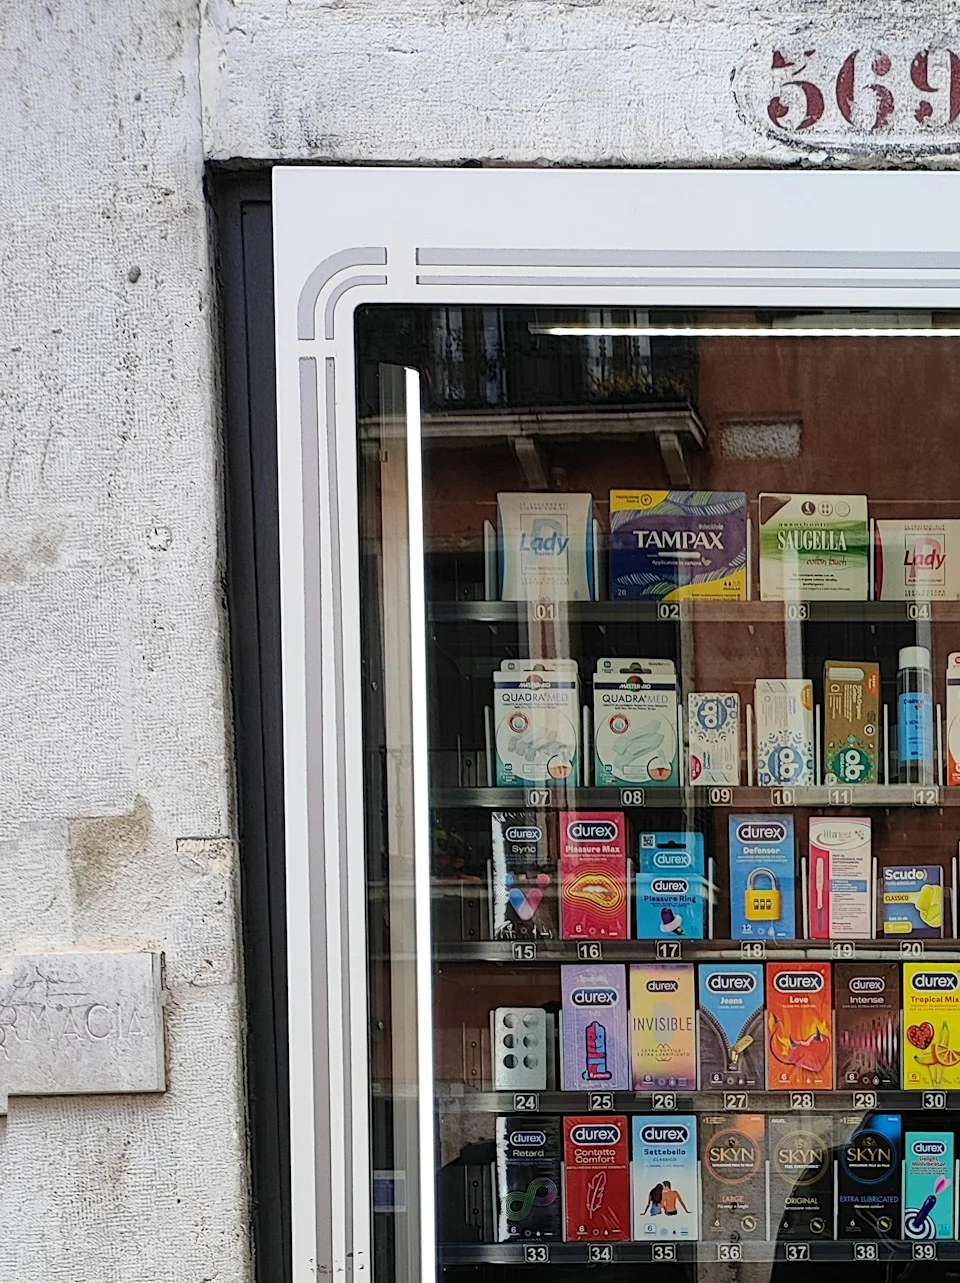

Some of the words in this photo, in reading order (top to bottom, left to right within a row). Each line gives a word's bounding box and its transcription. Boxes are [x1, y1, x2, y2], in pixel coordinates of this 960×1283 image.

[519, 532, 569, 557] Lady
[632, 530, 724, 550] TAMPAX
[777, 529, 848, 552] SAUGELLA
[903, 550, 946, 569] Lady
[536, 604, 554, 619] 01
[660, 604, 679, 619] 02
[788, 604, 807, 619] 03
[909, 605, 929, 619] 04
[508, 828, 540, 840] durex
[571, 823, 614, 840] durex
[740, 823, 783, 840] durex
[511, 844, 537, 855] Sync
[565, 845, 601, 854] Pleasure
[603, 845, 620, 854] Max
[743, 846, 781, 856] Defensor
[656, 852, 689, 867] durex
[885, 868, 925, 881] Scudo
[654, 879, 686, 893] durex
[644, 895, 677, 903] Pleasure
[678, 895, 697, 904] Ring
[885, 894, 909, 902] CLASSICO
[647, 980, 677, 992] durex
[710, 975, 753, 990] durex
[778, 975, 820, 990] durex
[851, 979, 883, 991] durex
[914, 973, 956, 989] durex
[574, 991, 614, 1004] durex
[720, 996, 744, 1006] Jeans
[789, 995, 809, 1005] Love
[850, 995, 884, 1004] Intense
[910, 995, 944, 1004] Tropical
[944, 995, 960, 1004] Mix
[633, 1017, 693, 1032] INVISIBLE
[516, 1095, 536, 1109] 24
[592, 1095, 611, 1109] 25
[655, 1094, 674, 1108] 26
[726, 1094, 745, 1108] 27
[792, 1094, 811, 1108] 28
[856, 1093, 875, 1108] 29
[925, 1093, 944, 1108] 30
[513, 1133, 543, 1145] durex
[573, 1127, 617, 1142] durex
[643, 1127, 686, 1141] durex
[512, 1149, 545, 1158] Retard
[574, 1148, 617, 1157] Contatto
[644, 1147, 686, 1157] Settebello
[709, 1147, 754, 1162] SKYN
[846, 1147, 891, 1162] SKYN
[915, 1142, 945, 1154] durex
[575, 1155, 616, 1164] Comfort
[778, 1149, 823, 1164] SKYN
[722, 1195, 745, 1203] LARGE
[784, 1197, 818, 1205] ORIGINAL
[839, 1195, 860, 1203] EXTRA
[860, 1195, 899, 1204] LUBRICATED
